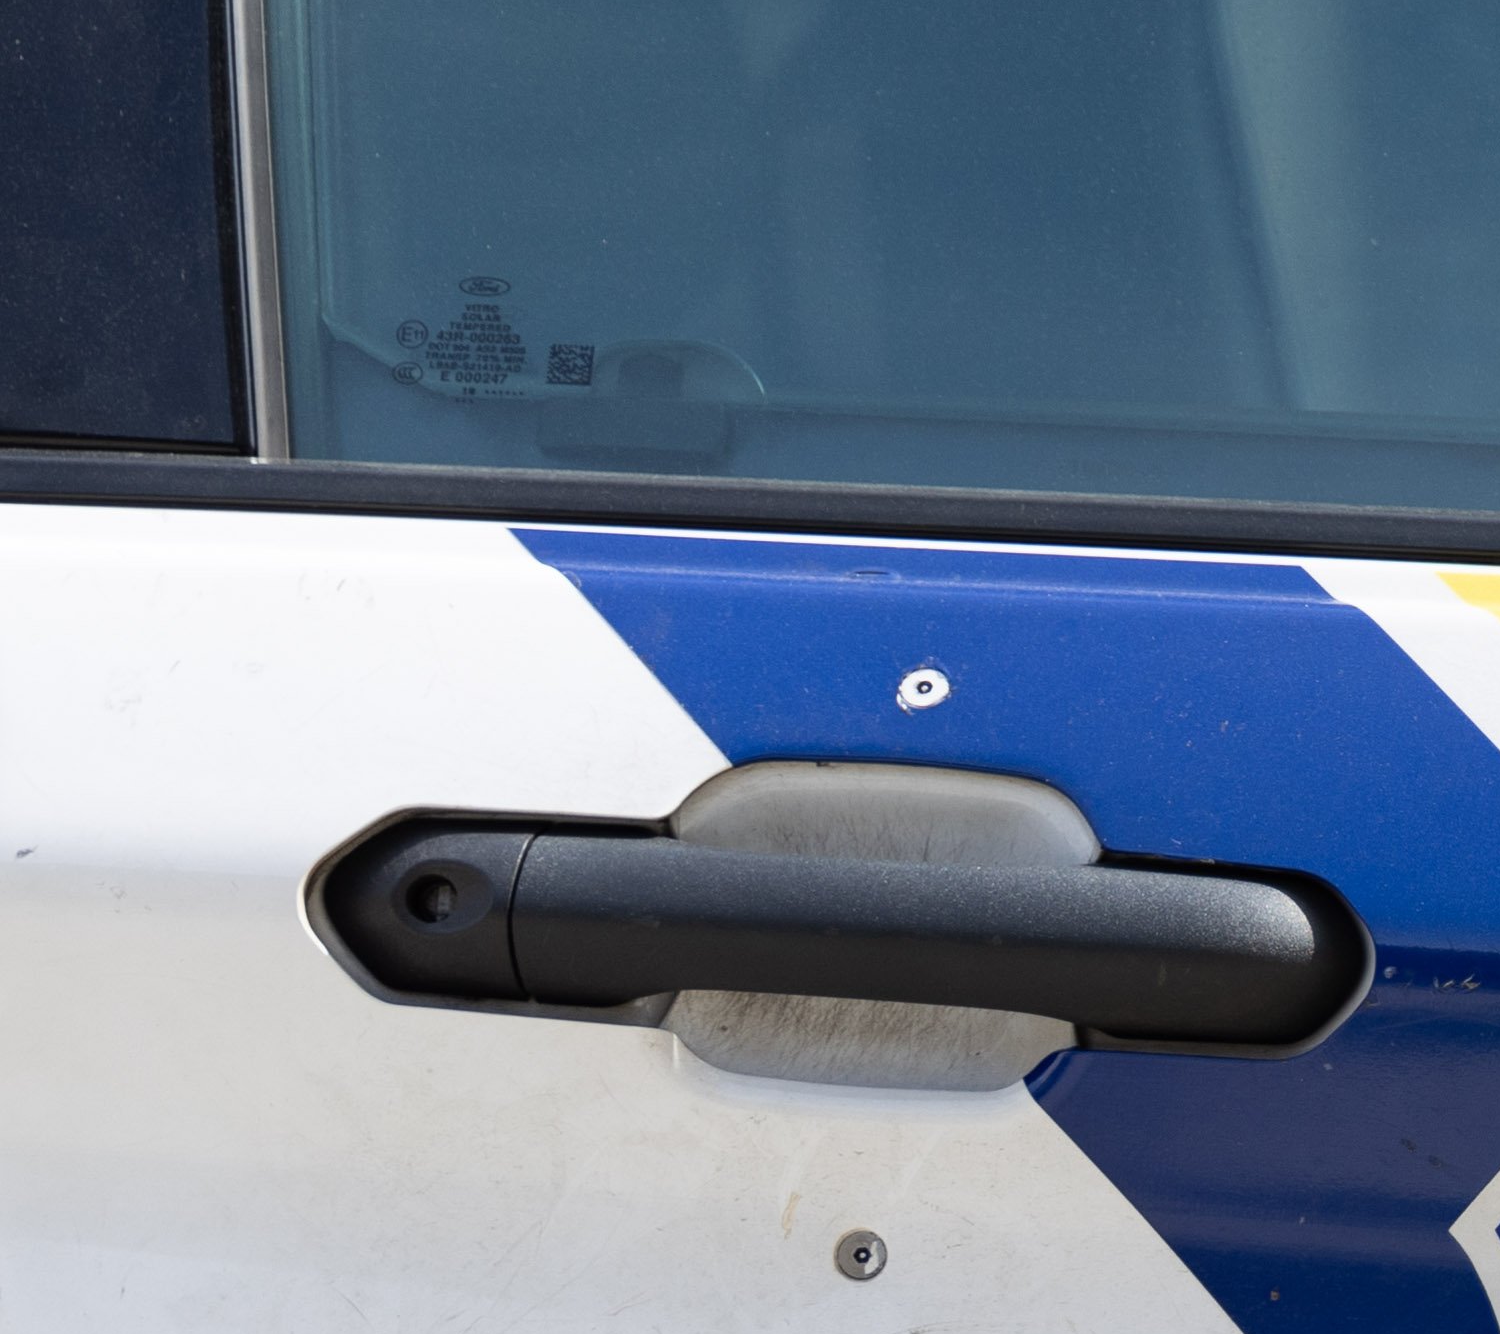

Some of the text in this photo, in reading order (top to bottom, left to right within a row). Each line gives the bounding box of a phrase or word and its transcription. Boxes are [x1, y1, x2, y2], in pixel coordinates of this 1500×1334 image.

[461, 312, 501, 322] SOLAR
[449, 321, 512, 332] TEMPERED
[440, 370, 508, 384] E 000247
